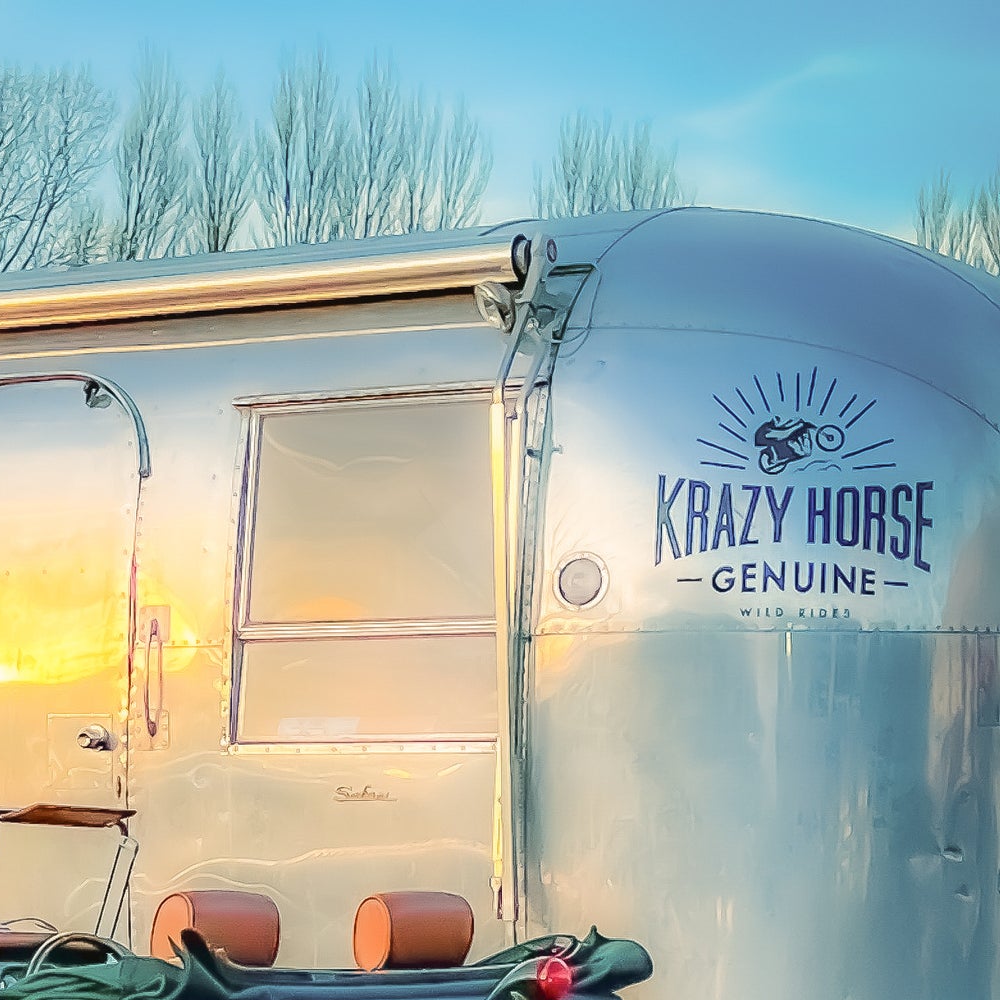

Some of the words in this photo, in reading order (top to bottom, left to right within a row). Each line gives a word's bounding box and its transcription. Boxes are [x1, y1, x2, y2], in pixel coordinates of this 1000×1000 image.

[655, 474, 794, 567] KRAZY
[807, 481, 934, 573] HORSE
[711, 561, 876, 596] GENUINE
[739, 607, 785, 618] WILD
